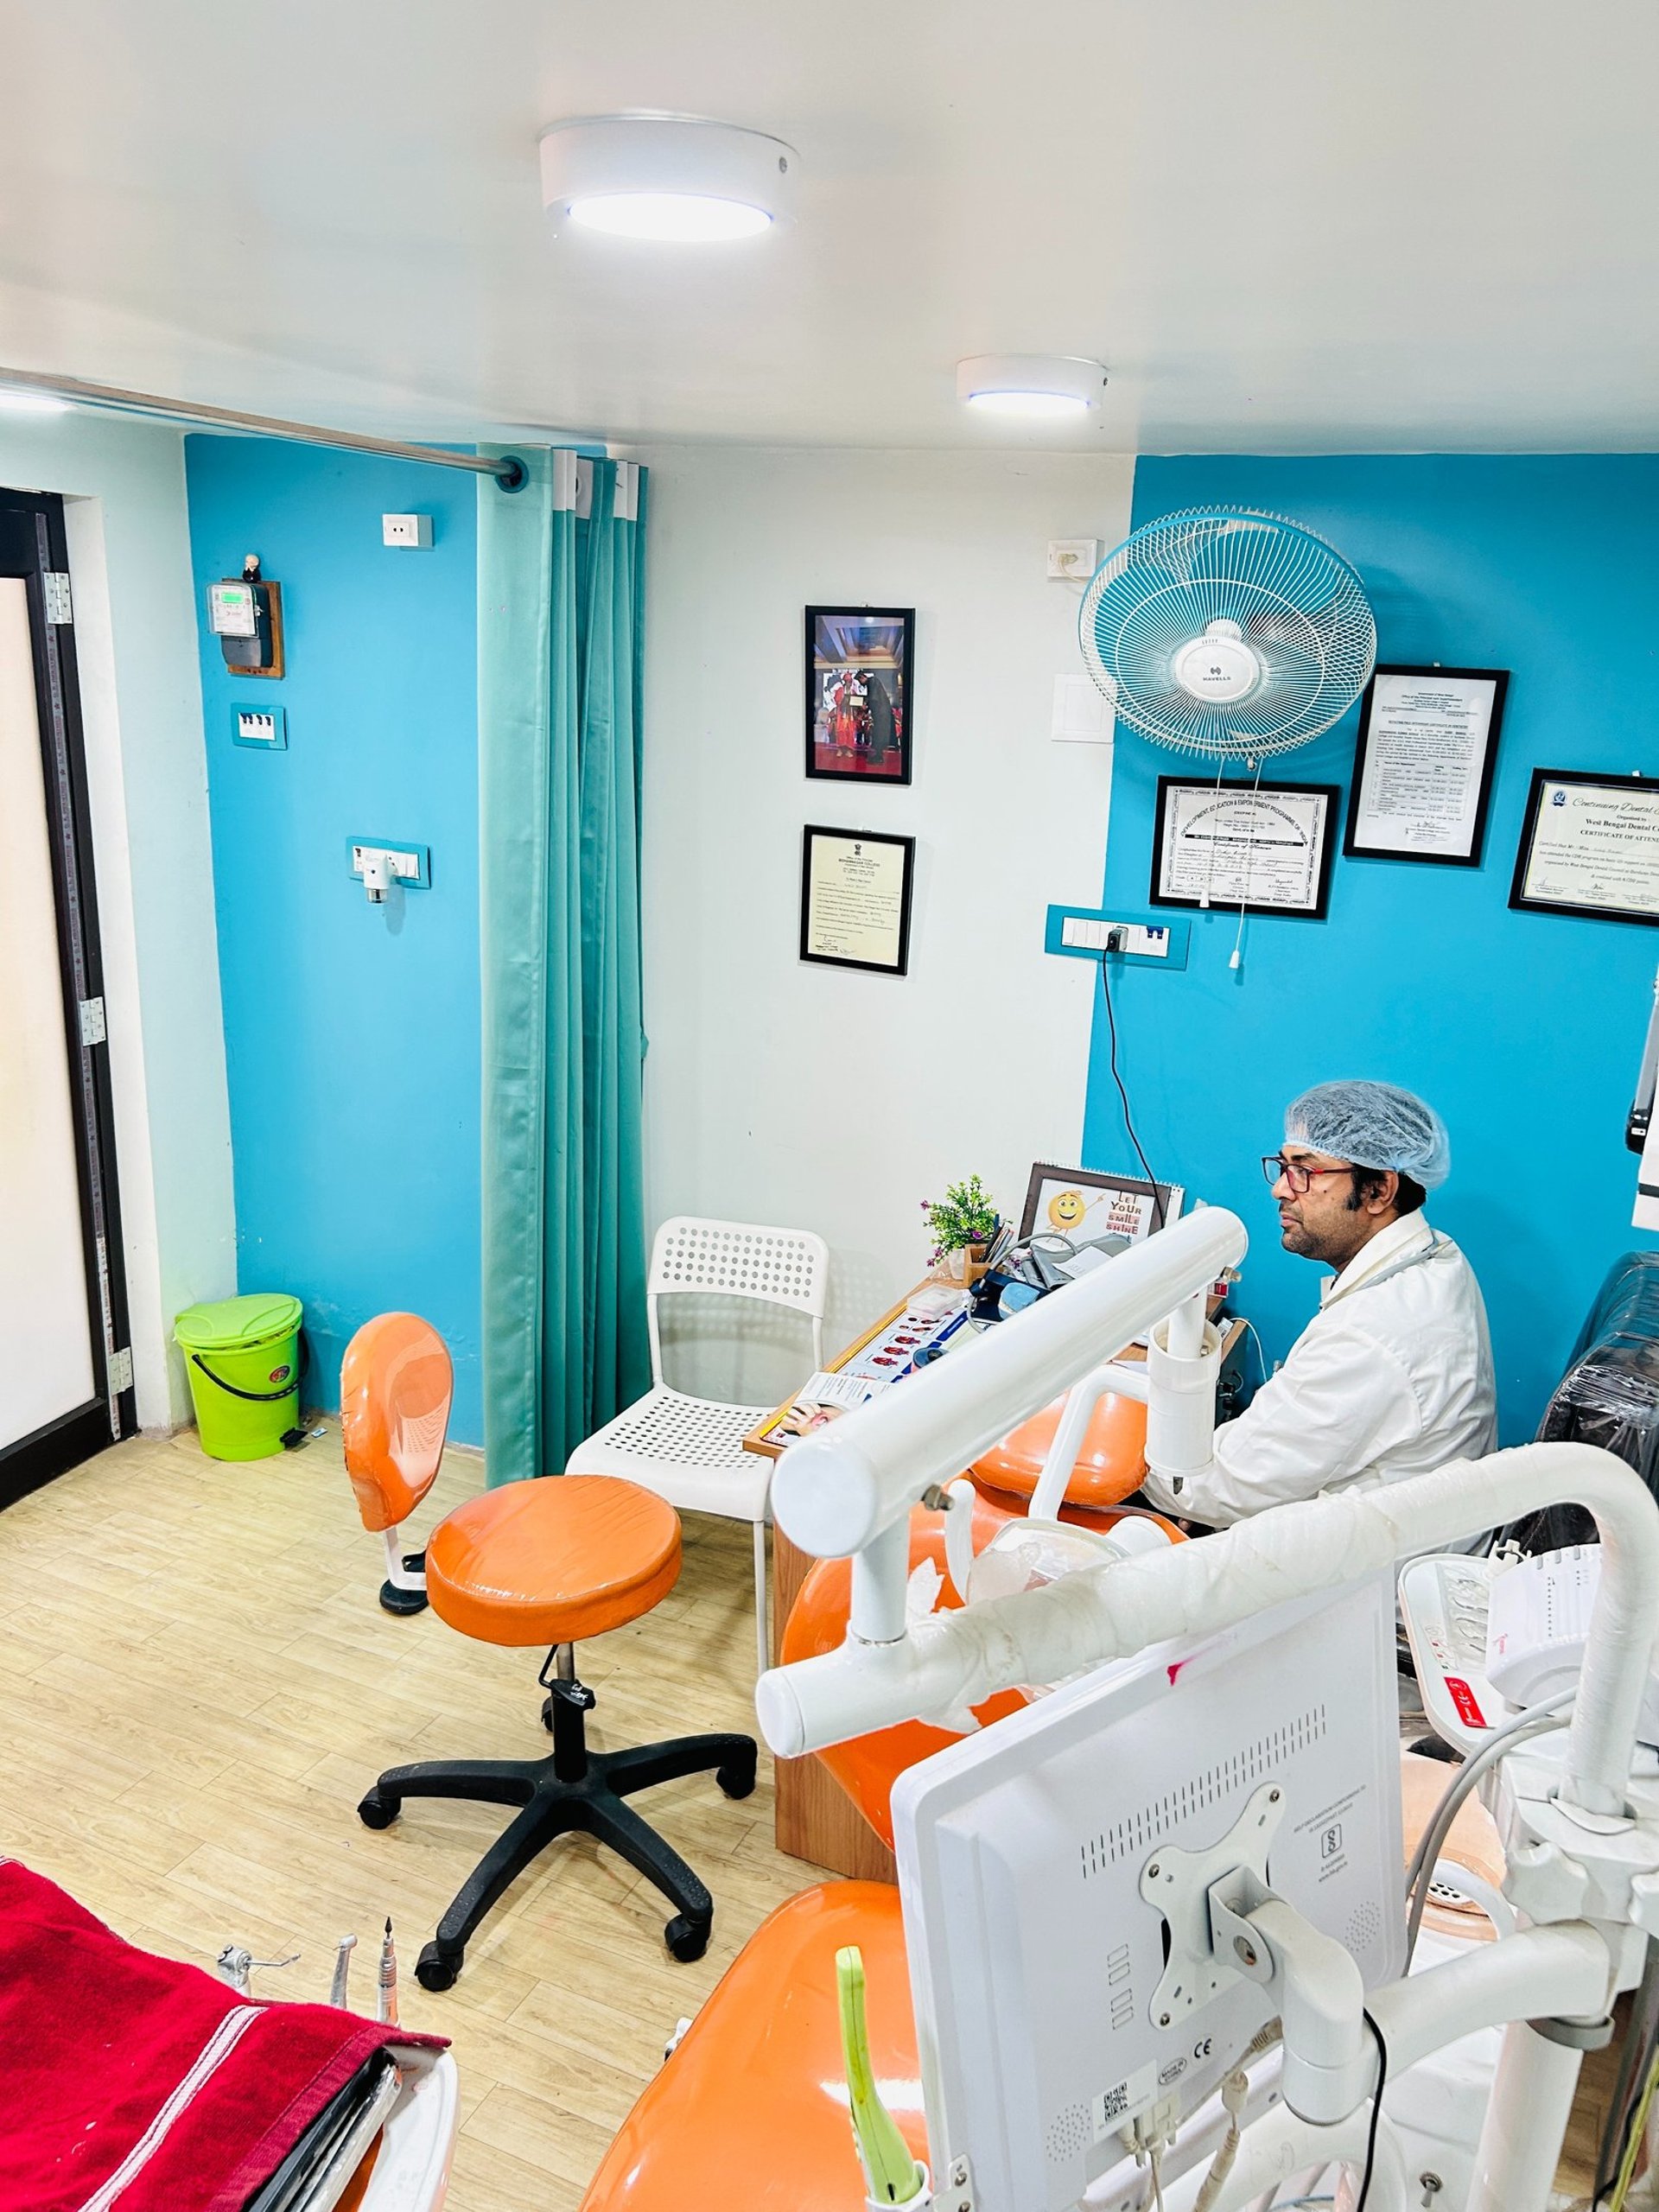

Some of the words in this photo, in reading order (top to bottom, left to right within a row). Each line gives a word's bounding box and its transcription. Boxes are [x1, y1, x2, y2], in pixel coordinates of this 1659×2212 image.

[1573, 798, 1619, 811] Continuing
[1620, 802, 1654, 813] Dental
[1586, 818, 1602, 827] West
[1603, 820, 1627, 830] Bengal
[1628, 823, 1651, 831] Dental
[1580, 830, 1623, 840] CERTIFICATE
[1118, 1191, 1139, 1205] LET
[1111, 1201, 1142, 1215] YOUR
[1108, 1213, 1140, 1225] SMILE
[1106, 1224, 1139, 1235] SHINE
